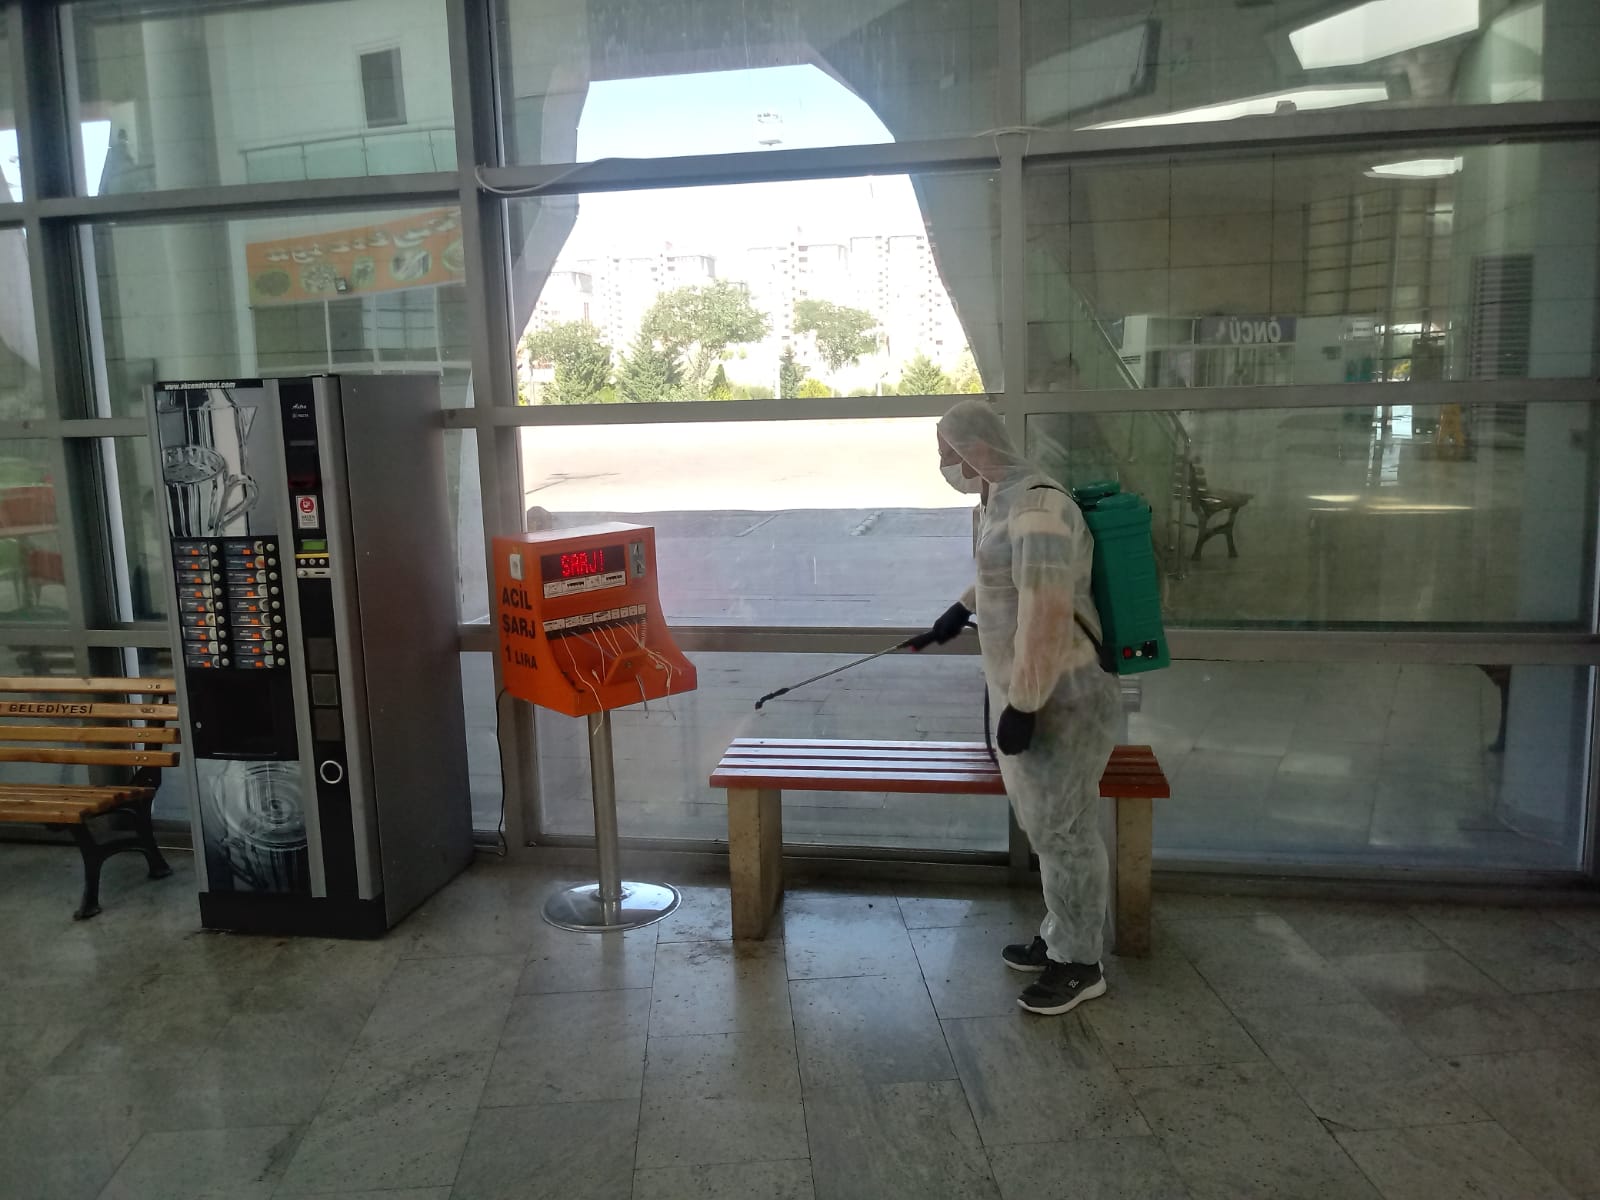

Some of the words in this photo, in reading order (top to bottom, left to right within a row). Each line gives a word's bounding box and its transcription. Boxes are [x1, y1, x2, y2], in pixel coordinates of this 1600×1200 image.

[502, 583, 532, 610] ACİL
[505, 644, 512, 663] 1
[8, 703, 93, 714] BELEDİYESİ
